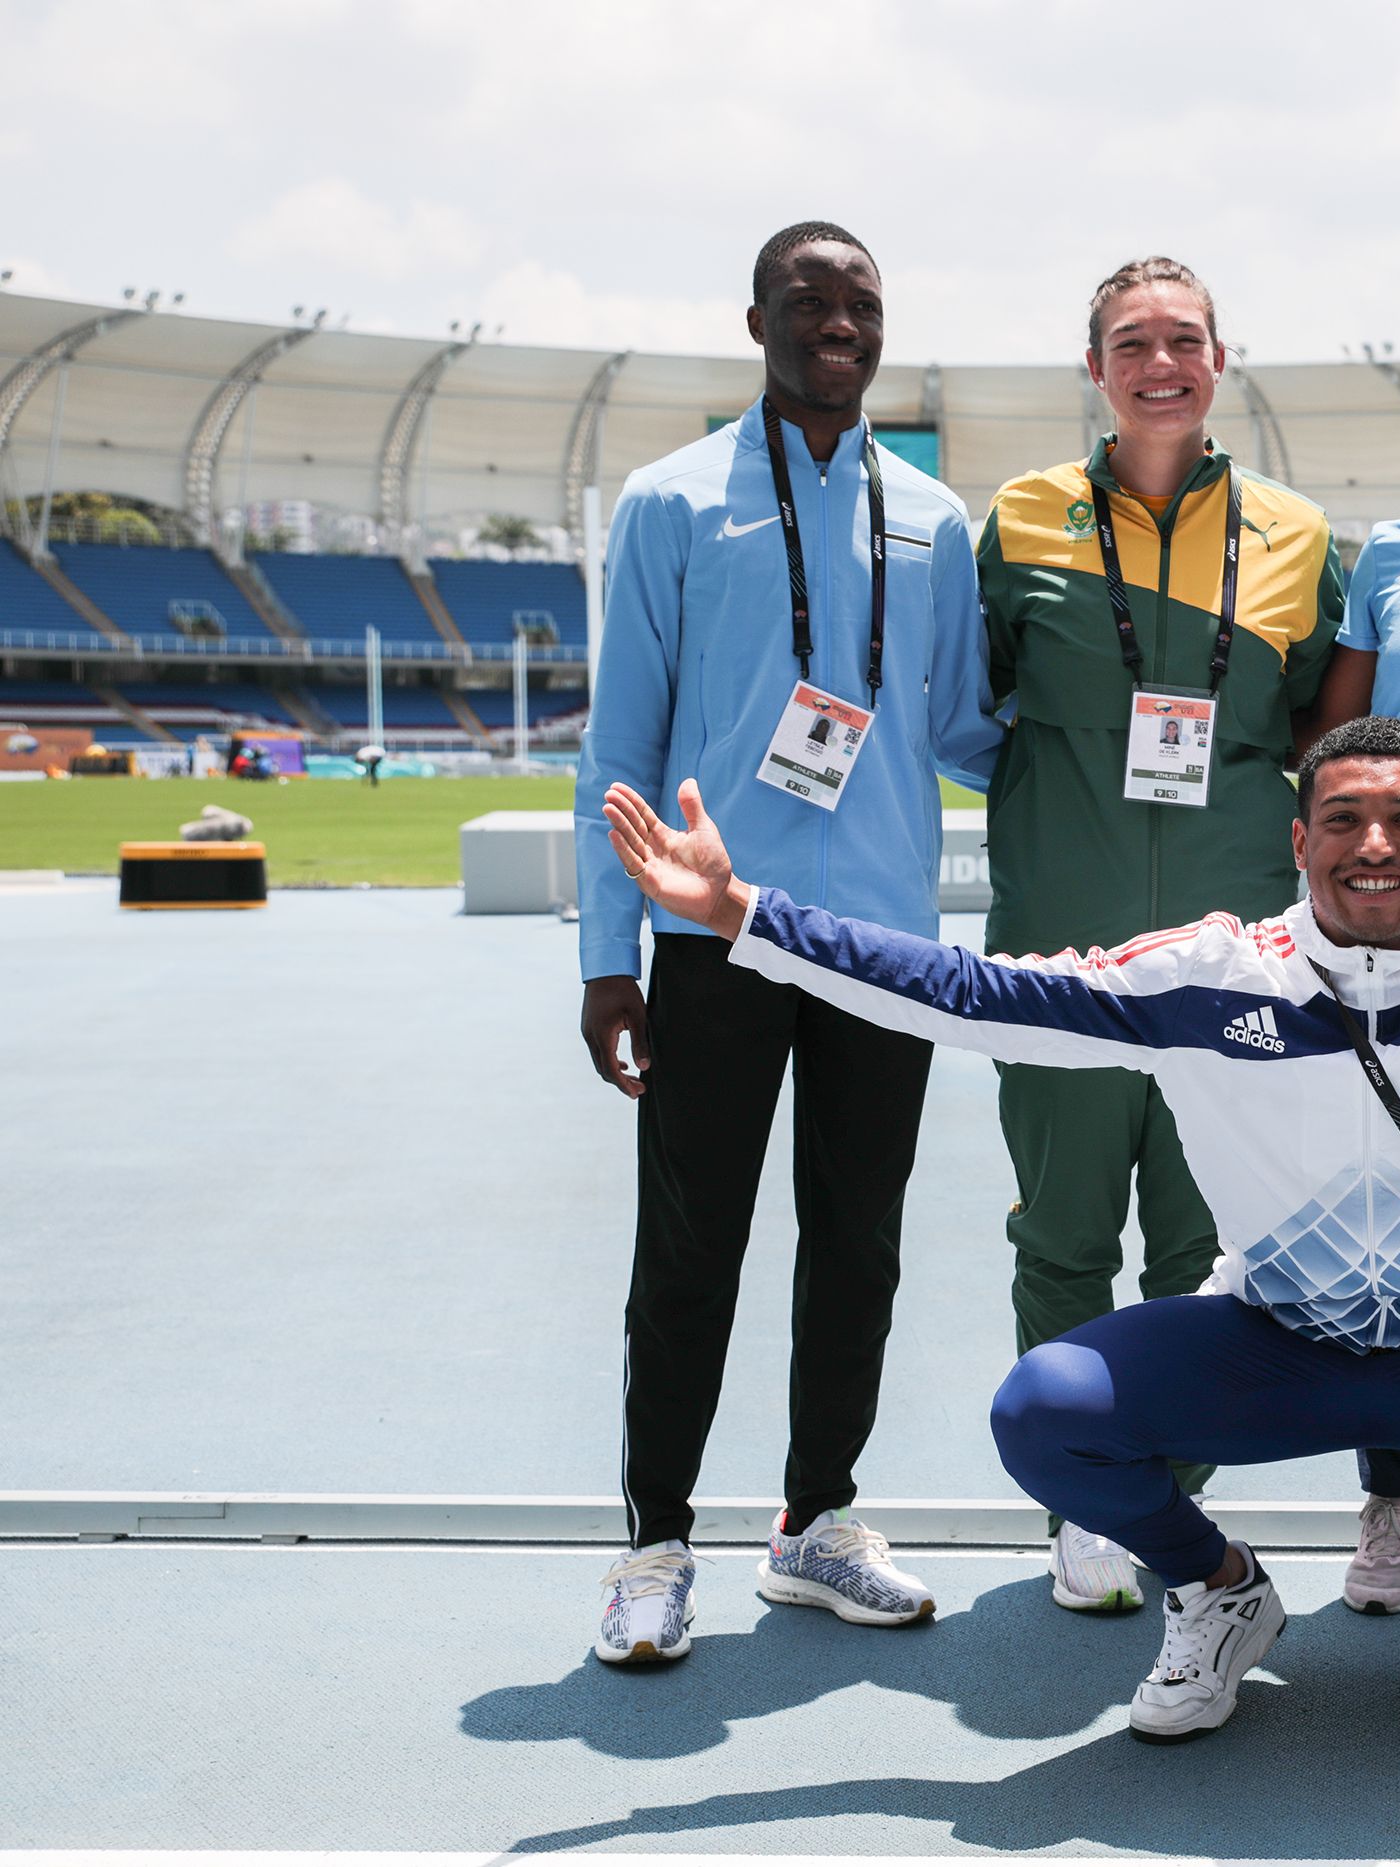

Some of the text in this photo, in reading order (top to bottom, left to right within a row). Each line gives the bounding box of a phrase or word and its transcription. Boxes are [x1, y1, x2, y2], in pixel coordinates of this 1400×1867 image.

[792, 764, 818, 779] ATHLETE
[1154, 773, 1180, 781] ATHLETE
[799, 785, 809, 795] 10
[1167, 791, 1177, 799] 10
[1223, 1025, 1286, 1054] adidas
